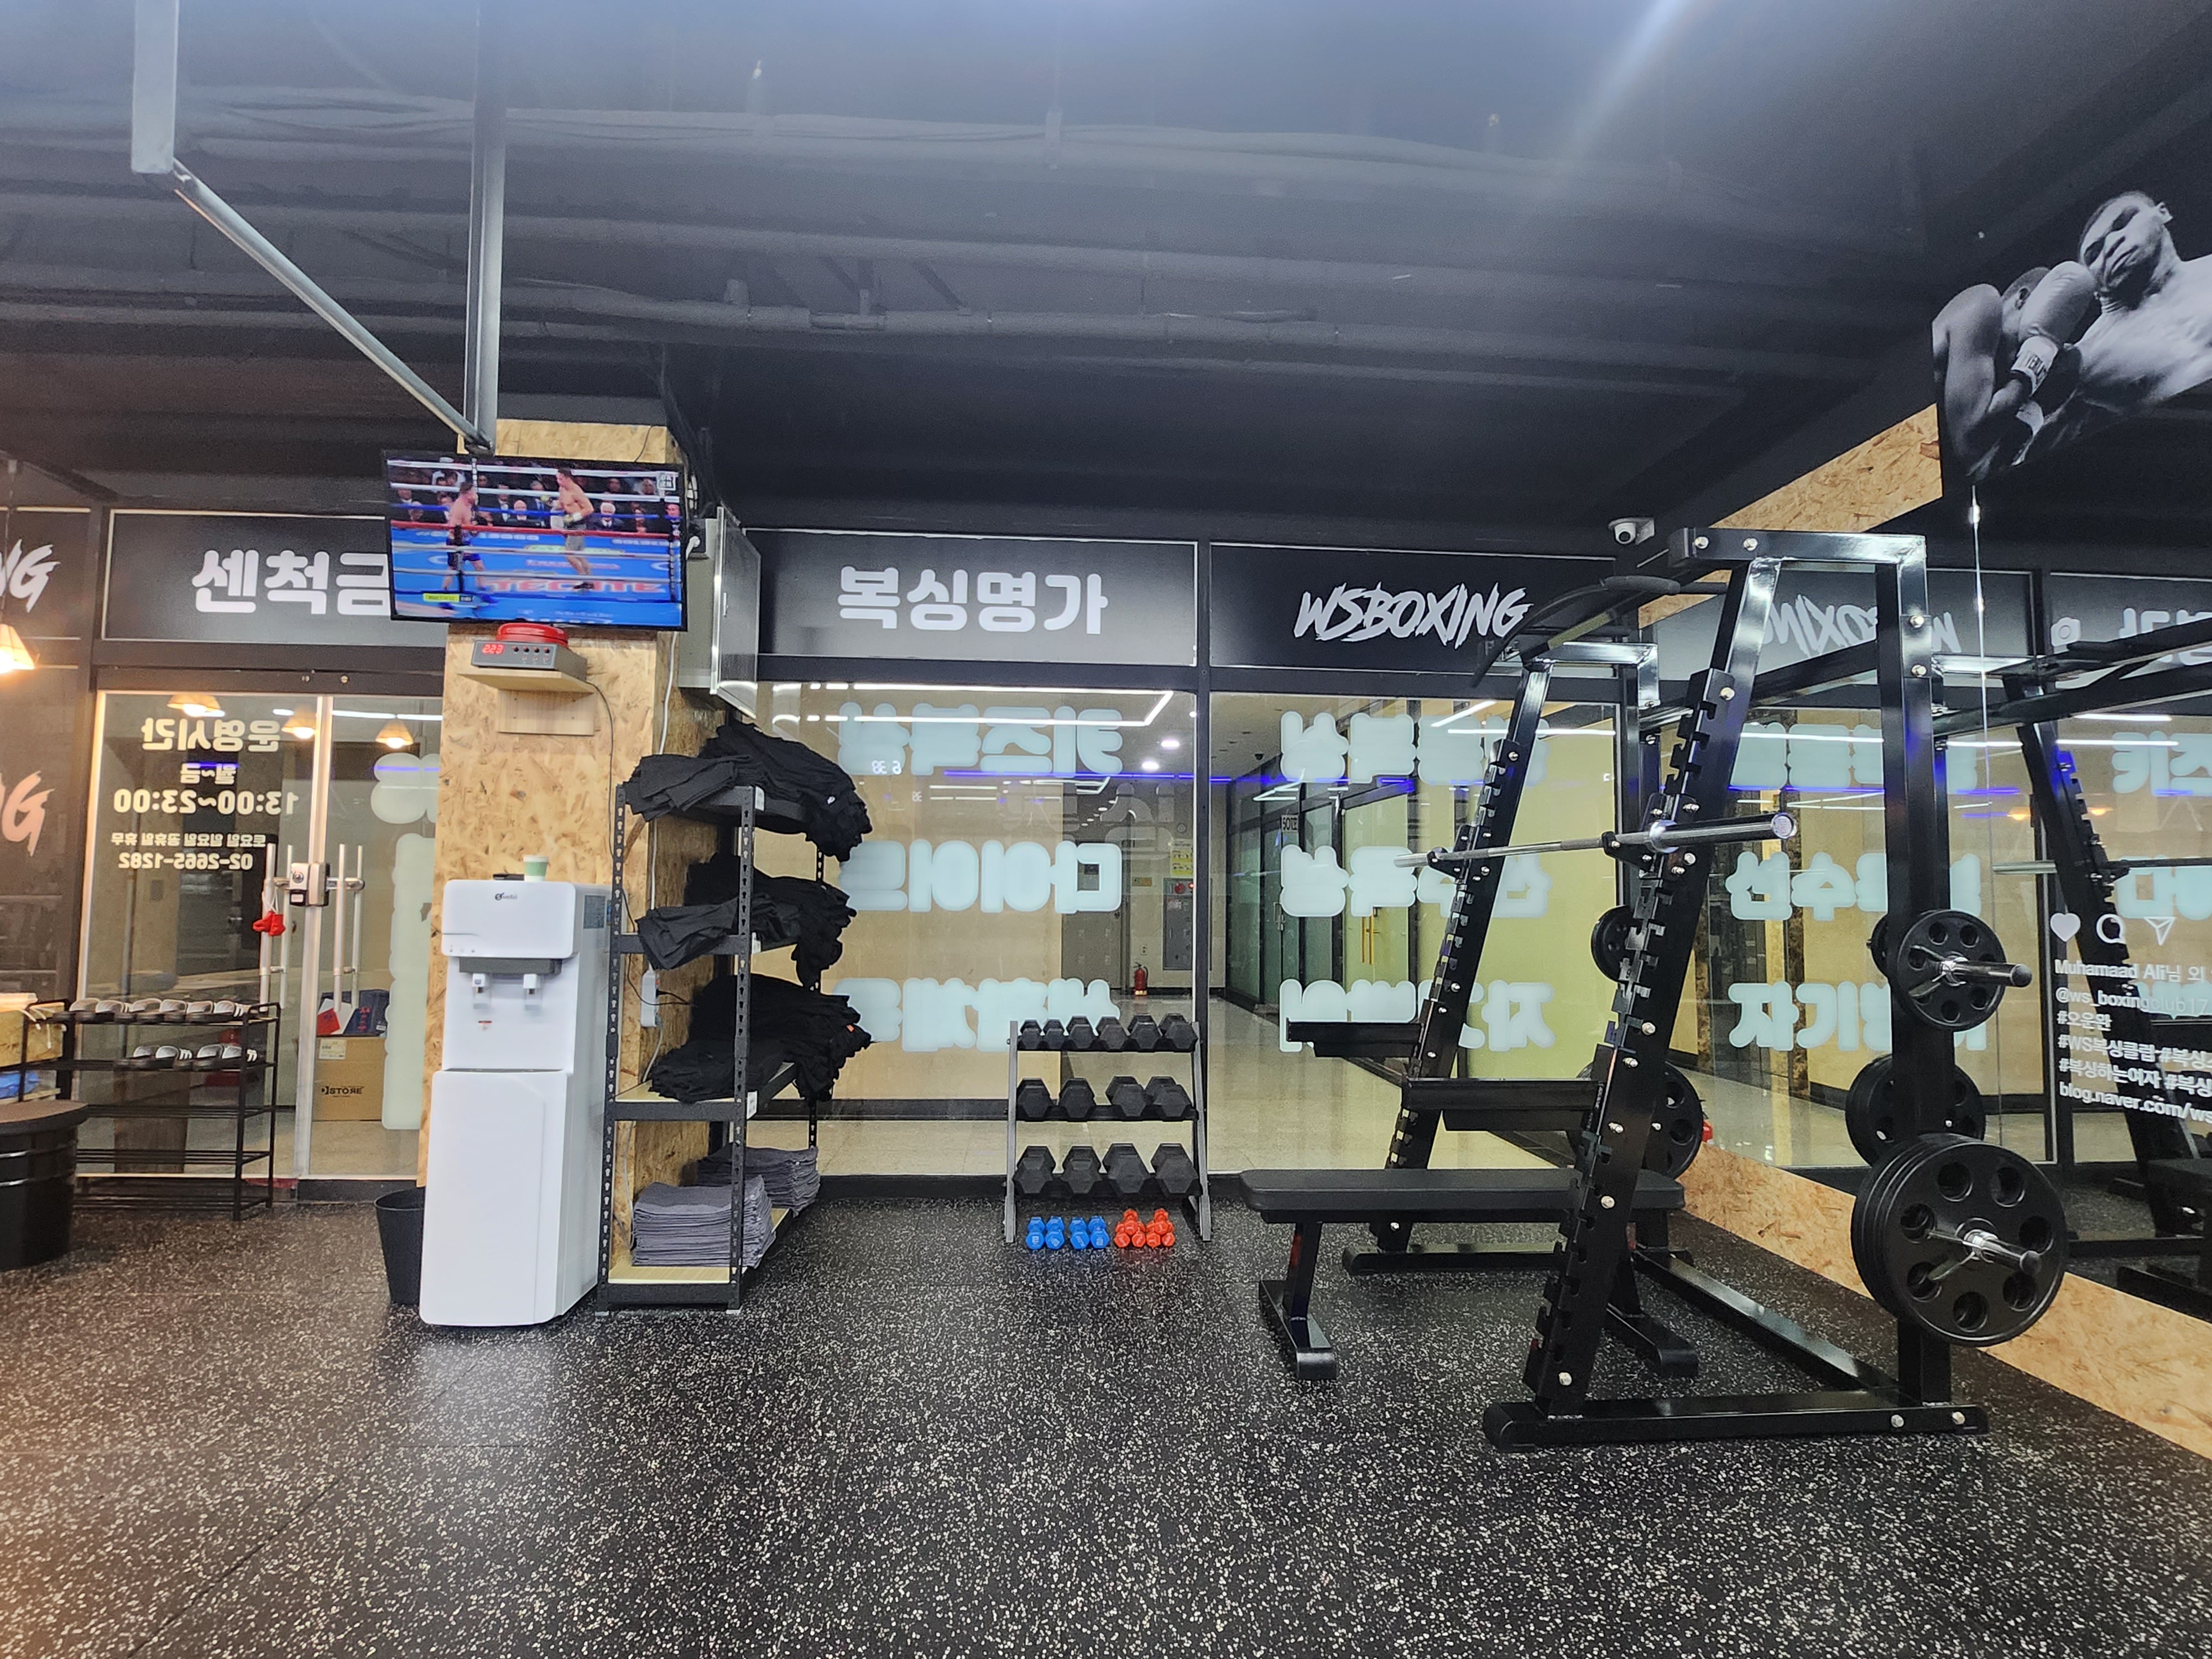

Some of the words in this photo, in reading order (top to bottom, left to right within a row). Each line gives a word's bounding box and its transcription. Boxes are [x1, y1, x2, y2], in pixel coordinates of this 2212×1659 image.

[838, 566, 1109, 634] 복싱명가
[1293, 582, 1534, 650] WSBOXING
[2054, 959, 2138, 978] Muhamaad
[2057, 1010, 2113, 1032] #오운완
[2058, 1057, 2162, 1089] #복싱하는여자
